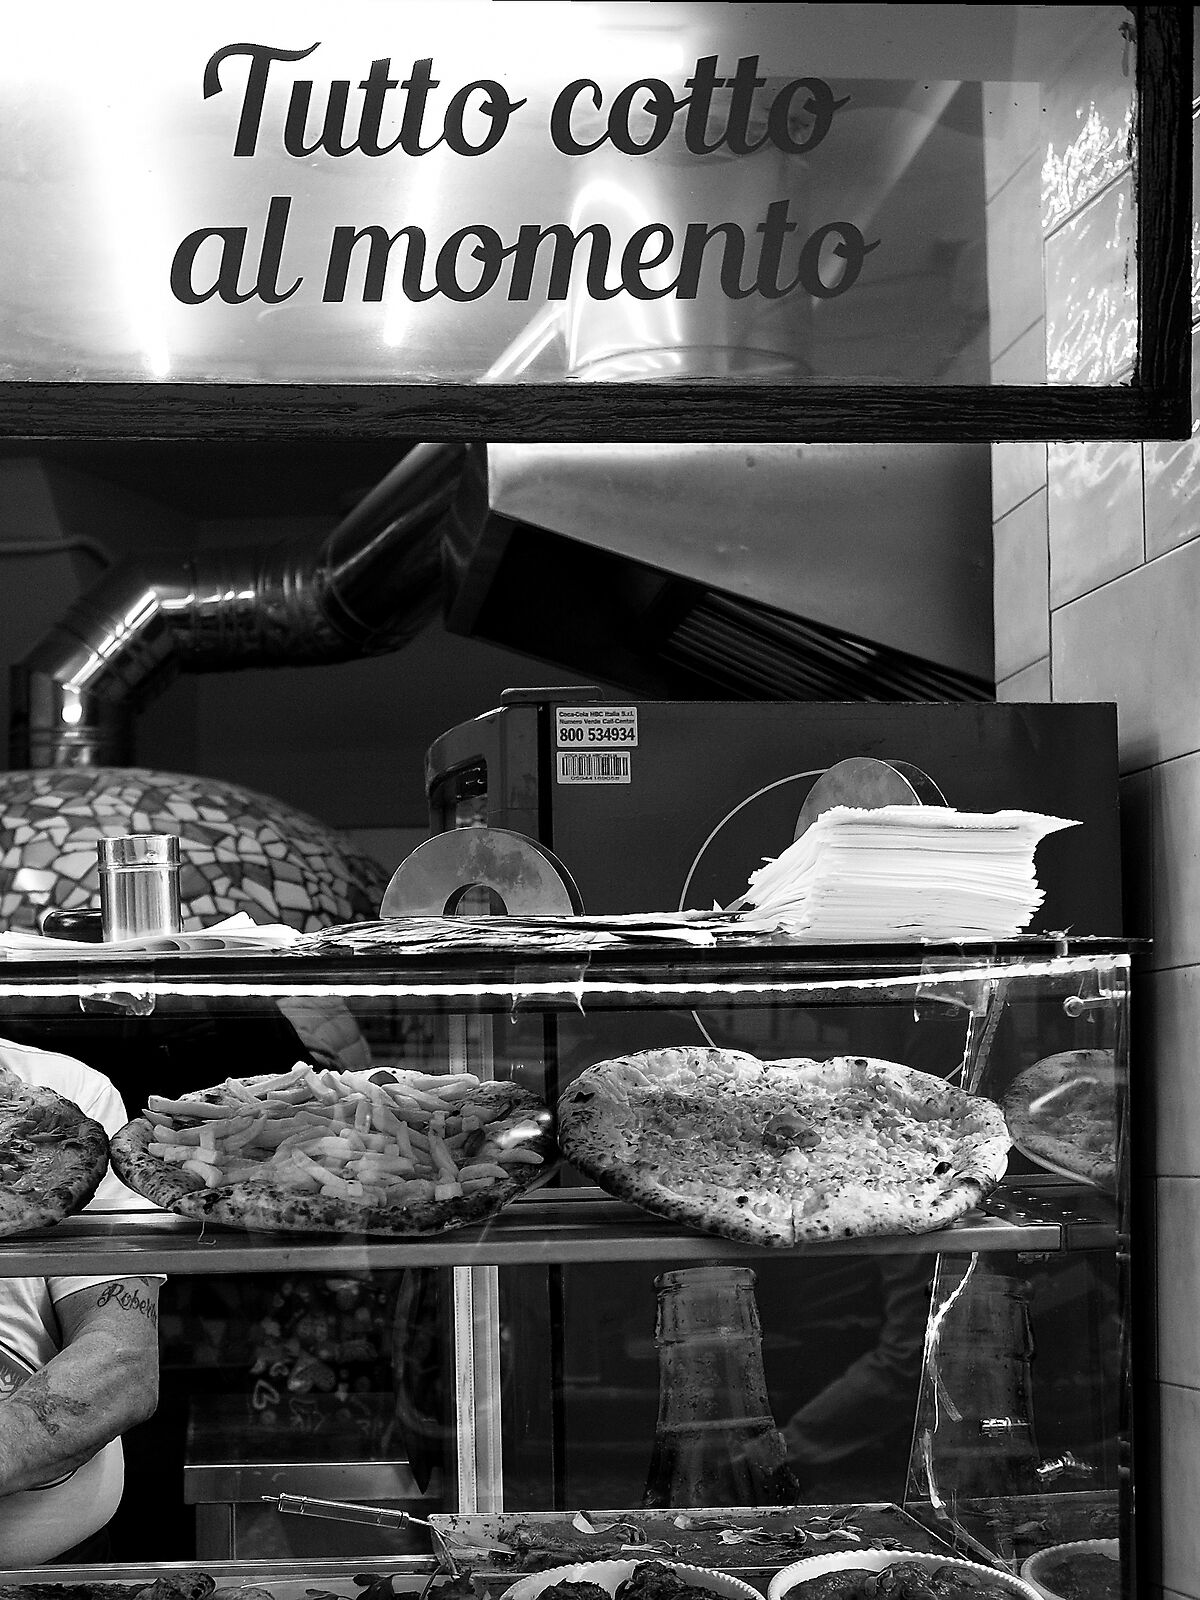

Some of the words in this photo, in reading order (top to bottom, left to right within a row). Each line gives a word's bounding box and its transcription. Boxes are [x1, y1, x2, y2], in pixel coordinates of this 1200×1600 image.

[202, 41, 528, 158] Tutto
[549, 53, 851, 158] cotto
[169, 196, 304, 305] al
[322, 199, 882, 304] momento
[559, 727, 584, 742] 800
[588, 727, 636, 742] 534934
